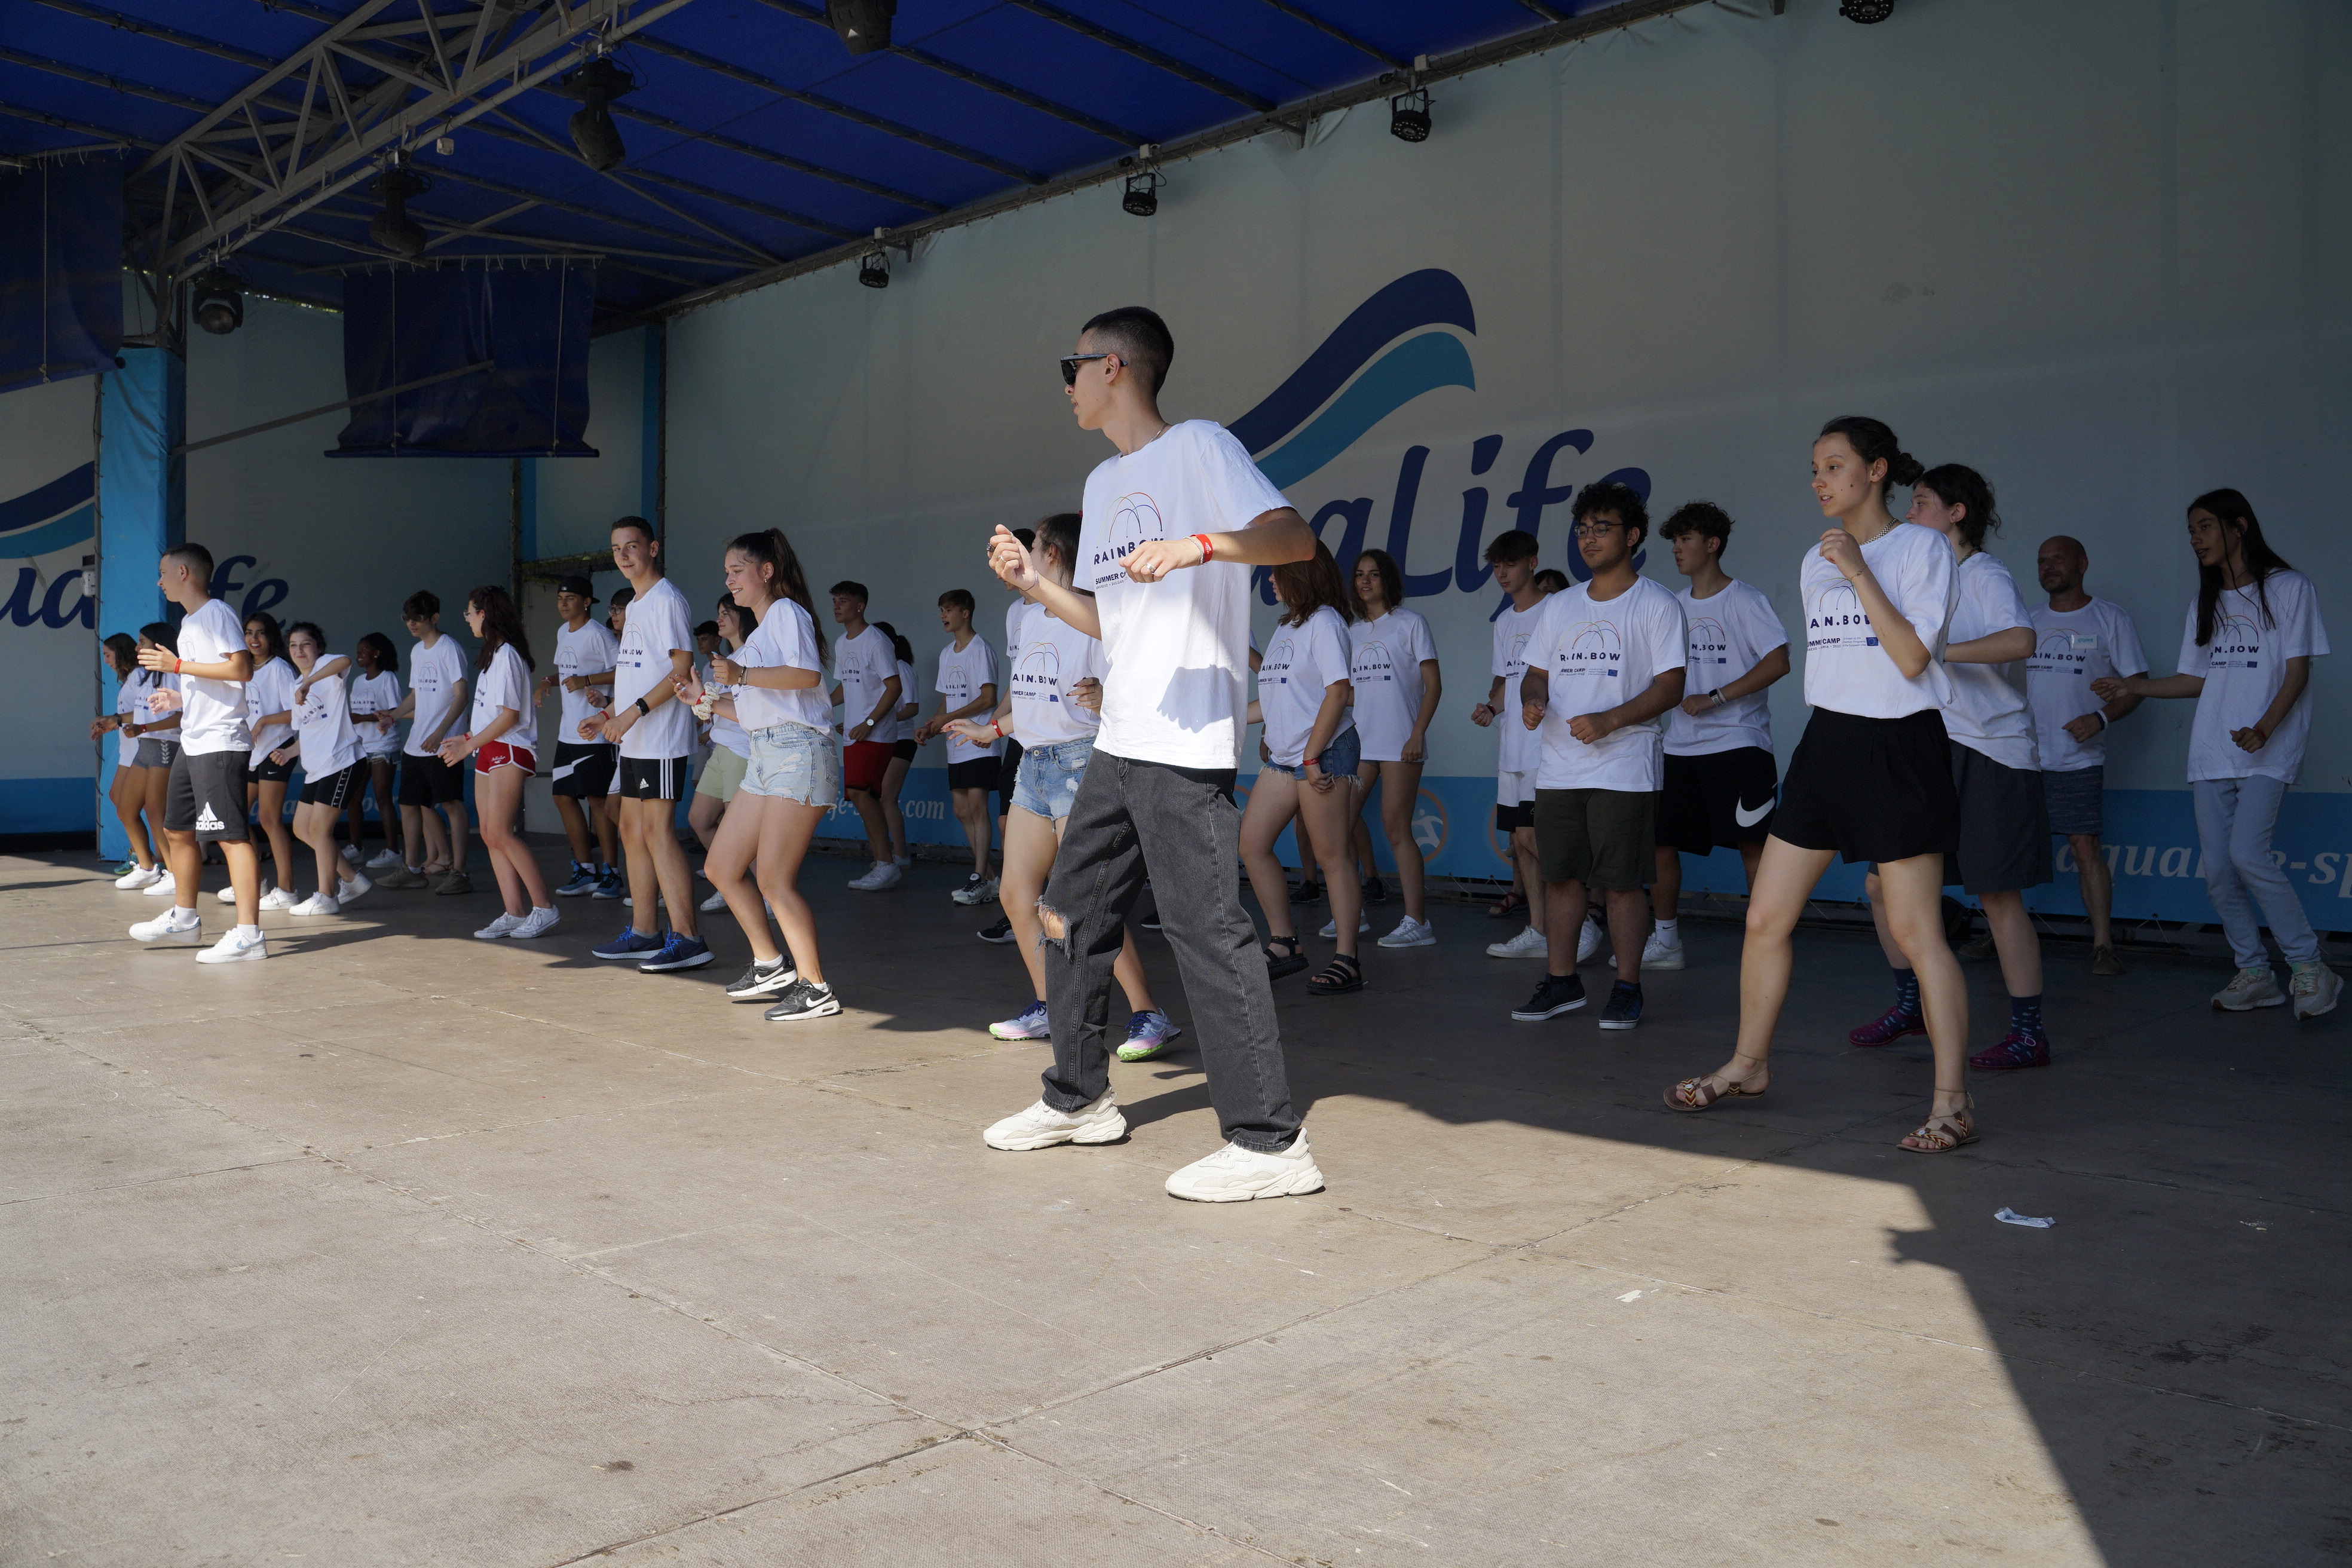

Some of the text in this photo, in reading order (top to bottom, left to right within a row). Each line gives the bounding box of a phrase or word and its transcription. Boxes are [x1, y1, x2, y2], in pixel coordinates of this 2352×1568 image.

[1095, 573, 1119, 584] SUMMER
[1810, 614, 1870, 629] AN.BO
[1260, 663, 1290, 672] AIN.BOW
[1353, 664, 1391, 673] RIN.BOW
